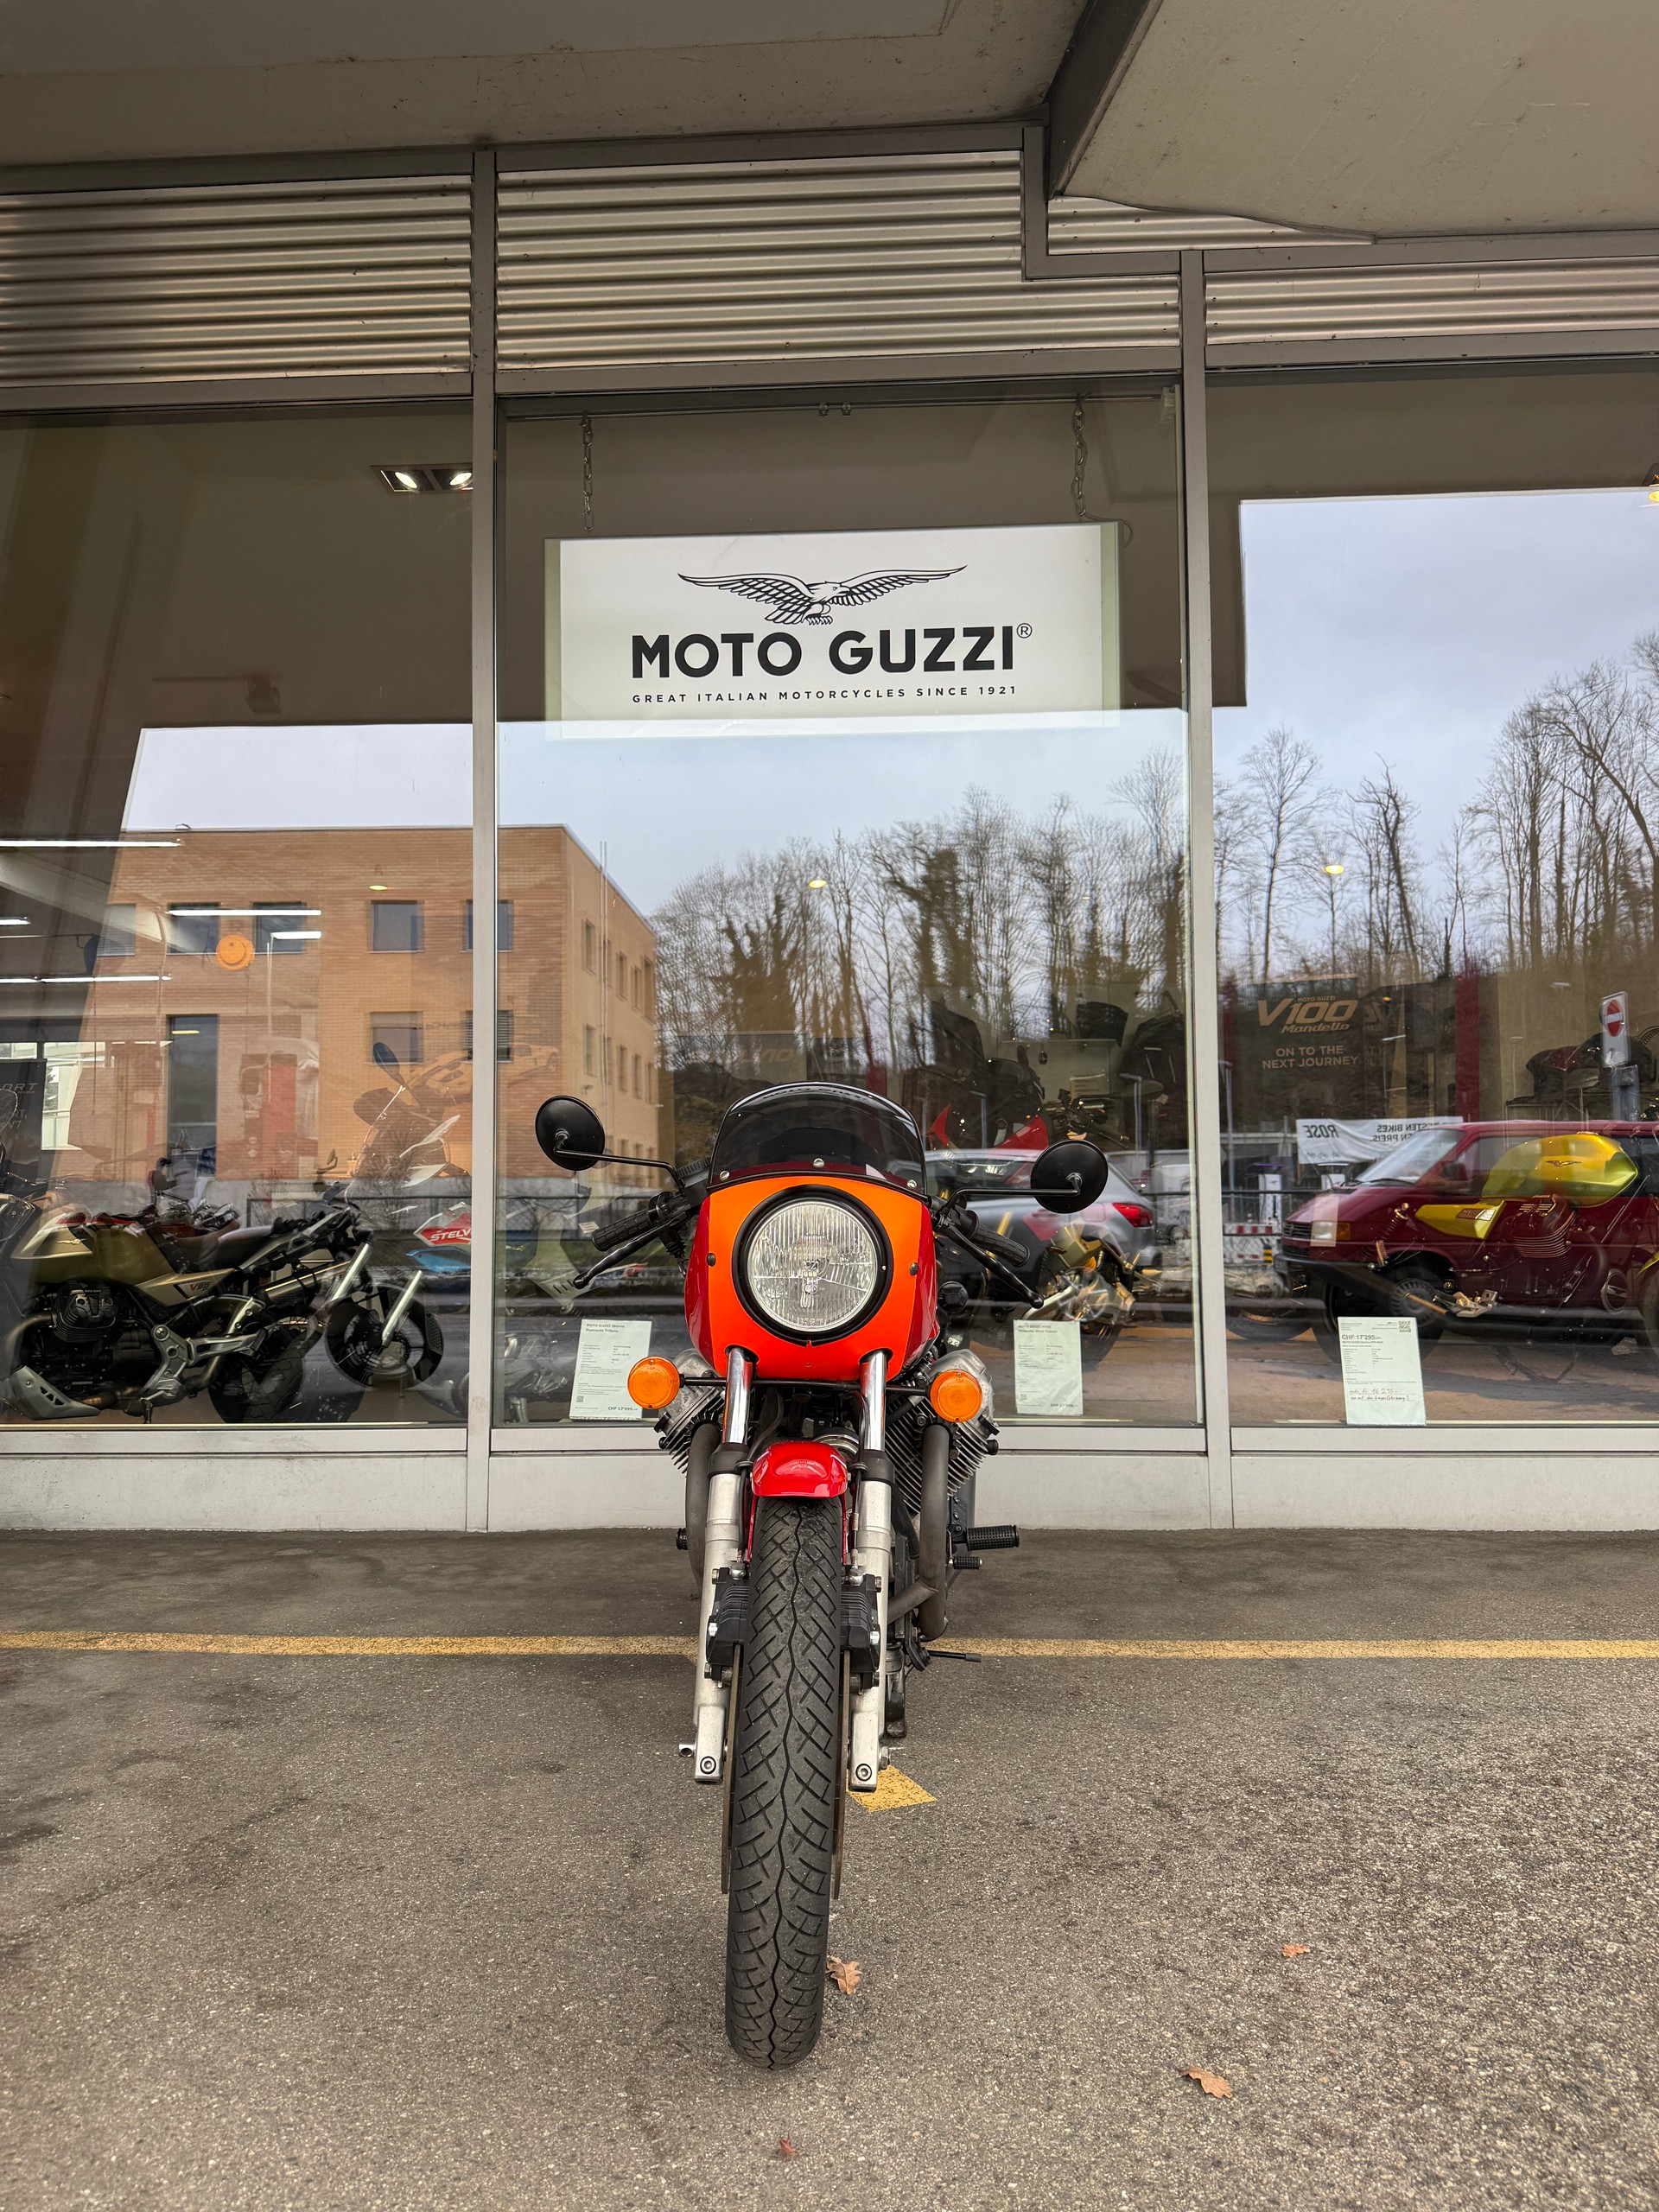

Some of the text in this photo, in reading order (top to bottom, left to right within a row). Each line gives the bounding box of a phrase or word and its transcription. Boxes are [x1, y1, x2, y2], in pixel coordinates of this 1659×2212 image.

[632, 632, 803, 678] MOTO
[632, 686, 1016, 703] GREAT ITALIAN MOTORCYCLES SINCE 1921
[1257, 998, 1358, 1027] V100
[1281, 1022, 1350, 1034] Mandello
[1275, 1045, 1344, 1057] ON TO THE
[1262, 1059, 1294, 1069] NEXT
[1298, 1056, 1358, 1068] JOURNEY
[429, 1228, 471, 1242] STELV
